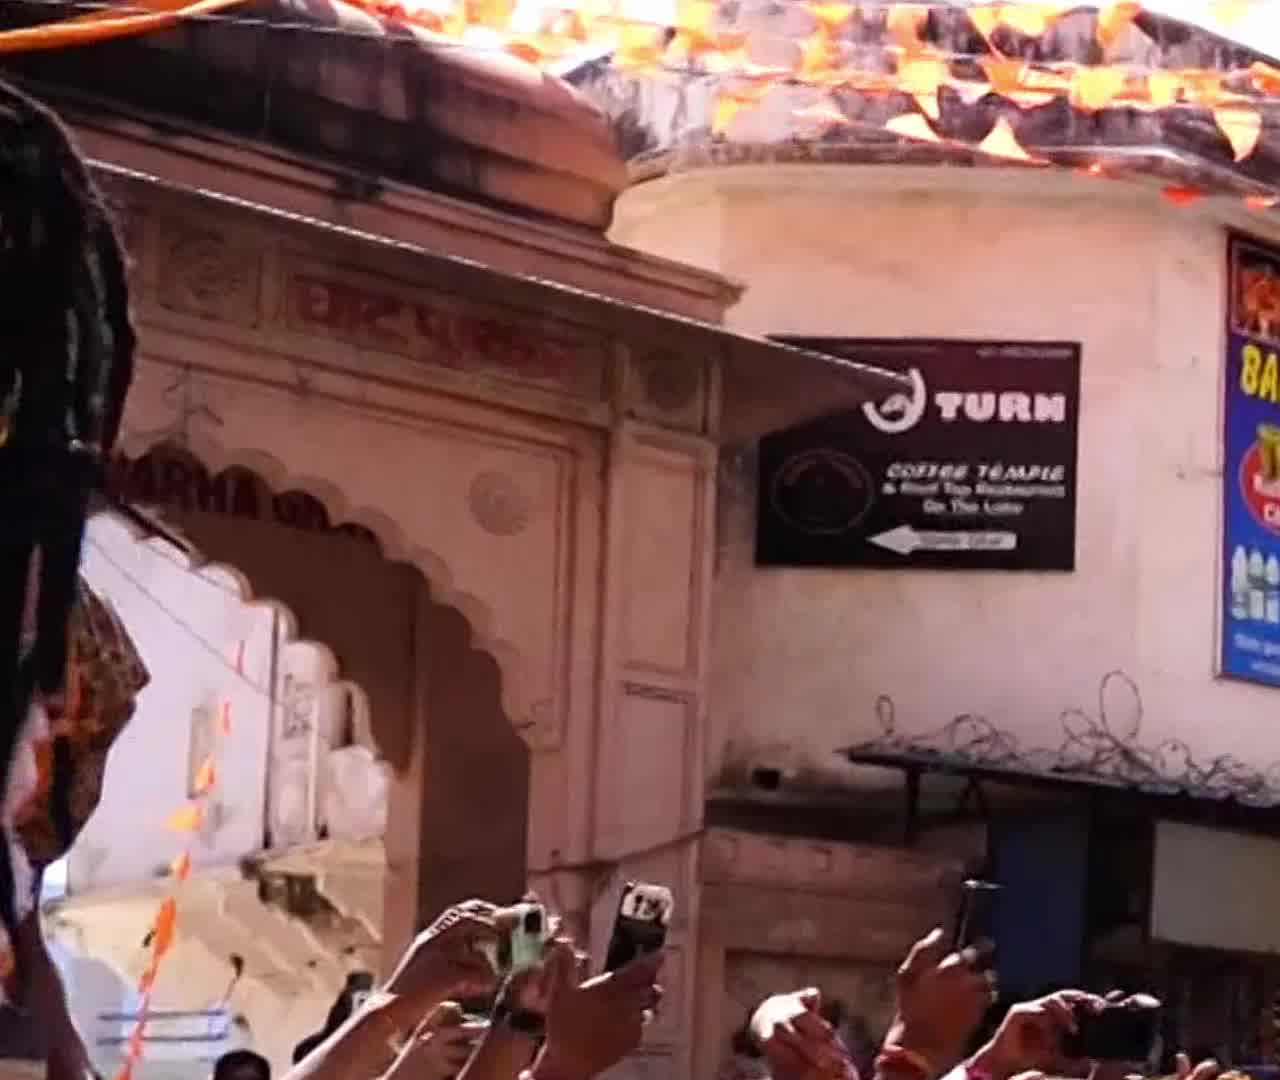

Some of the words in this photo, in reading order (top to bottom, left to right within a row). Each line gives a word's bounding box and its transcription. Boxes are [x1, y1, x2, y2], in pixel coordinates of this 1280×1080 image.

[935, 392, 1067, 422] TURN
[886, 462, 969, 480] COFFEE
[975, 463, 1066, 482] TEMPLE
